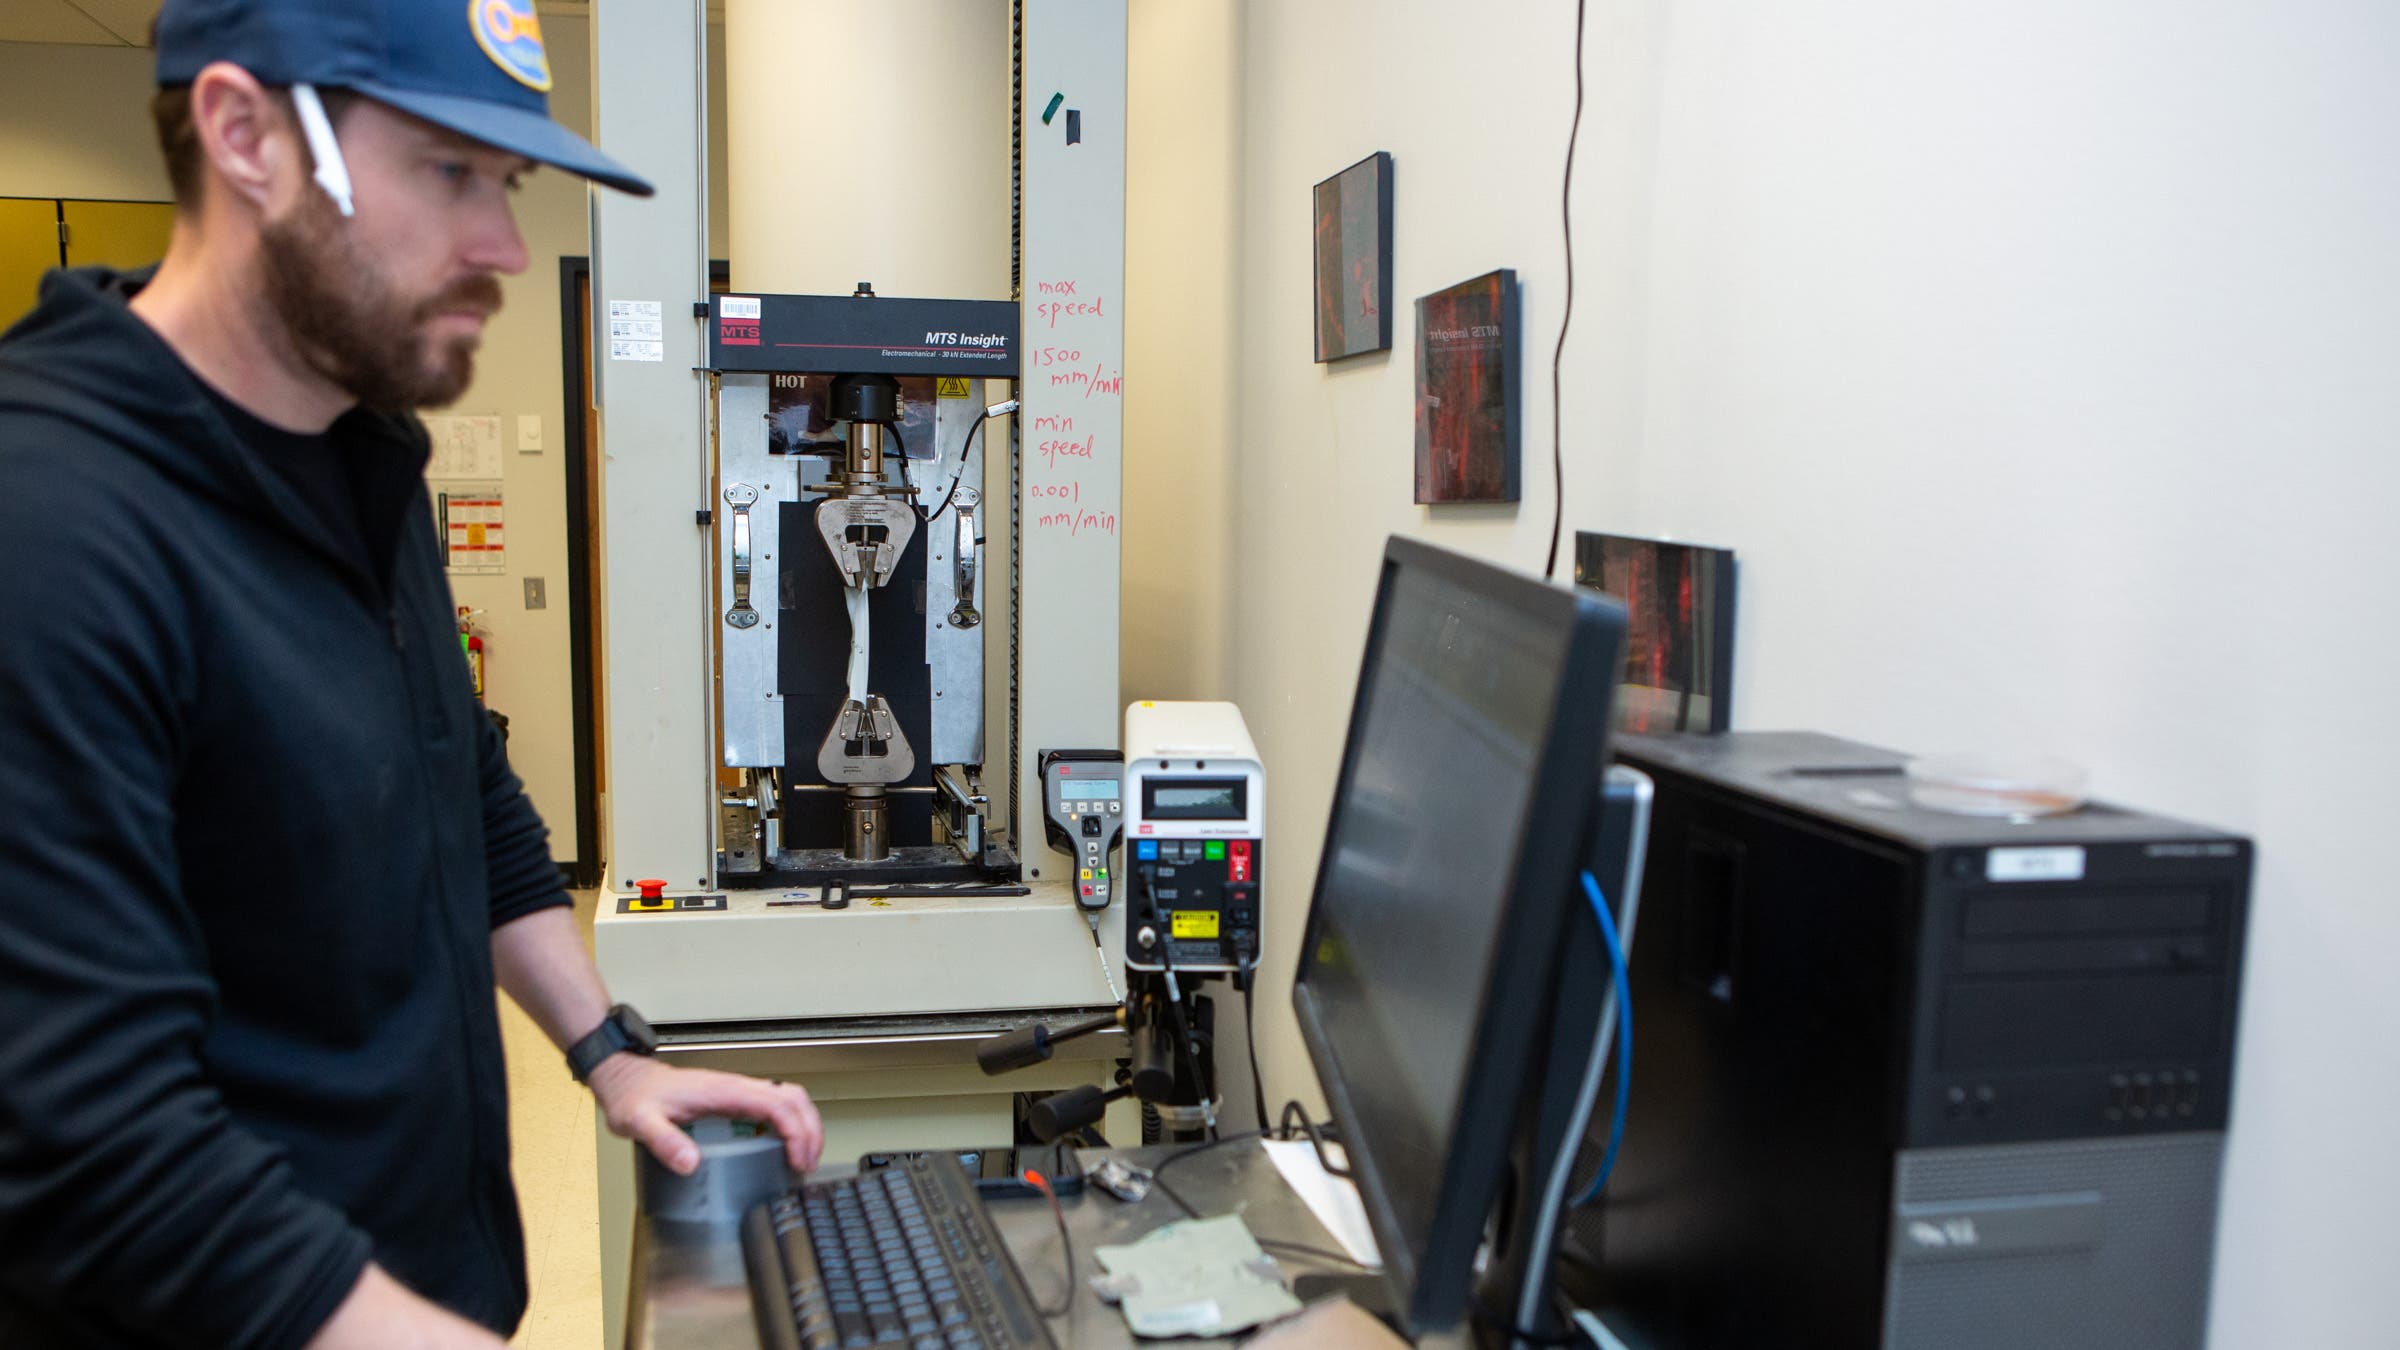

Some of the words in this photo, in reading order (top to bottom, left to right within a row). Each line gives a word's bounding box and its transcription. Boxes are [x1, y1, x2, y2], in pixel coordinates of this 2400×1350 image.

[1038, 280, 1076, 296] max
[1037, 296, 1104, 329] speed
[720, 326, 761, 338] MTS
[925, 331, 958, 345] MTS
[959, 332, 1006, 349] Insight
[881, 349, 937, 358] Electromechanical
[959, 351, 987, 360] Extended
[987, 352, 1008, 361] Length
[1033, 347, 1081, 367] 1500
[775, 374, 808, 389] HOT
[1034, 414, 1073, 433] min
[1039, 434, 1095, 470] speed
[1031, 481, 1079, 503] 0.001
[1039, 508, 1116, 537] mm/min
